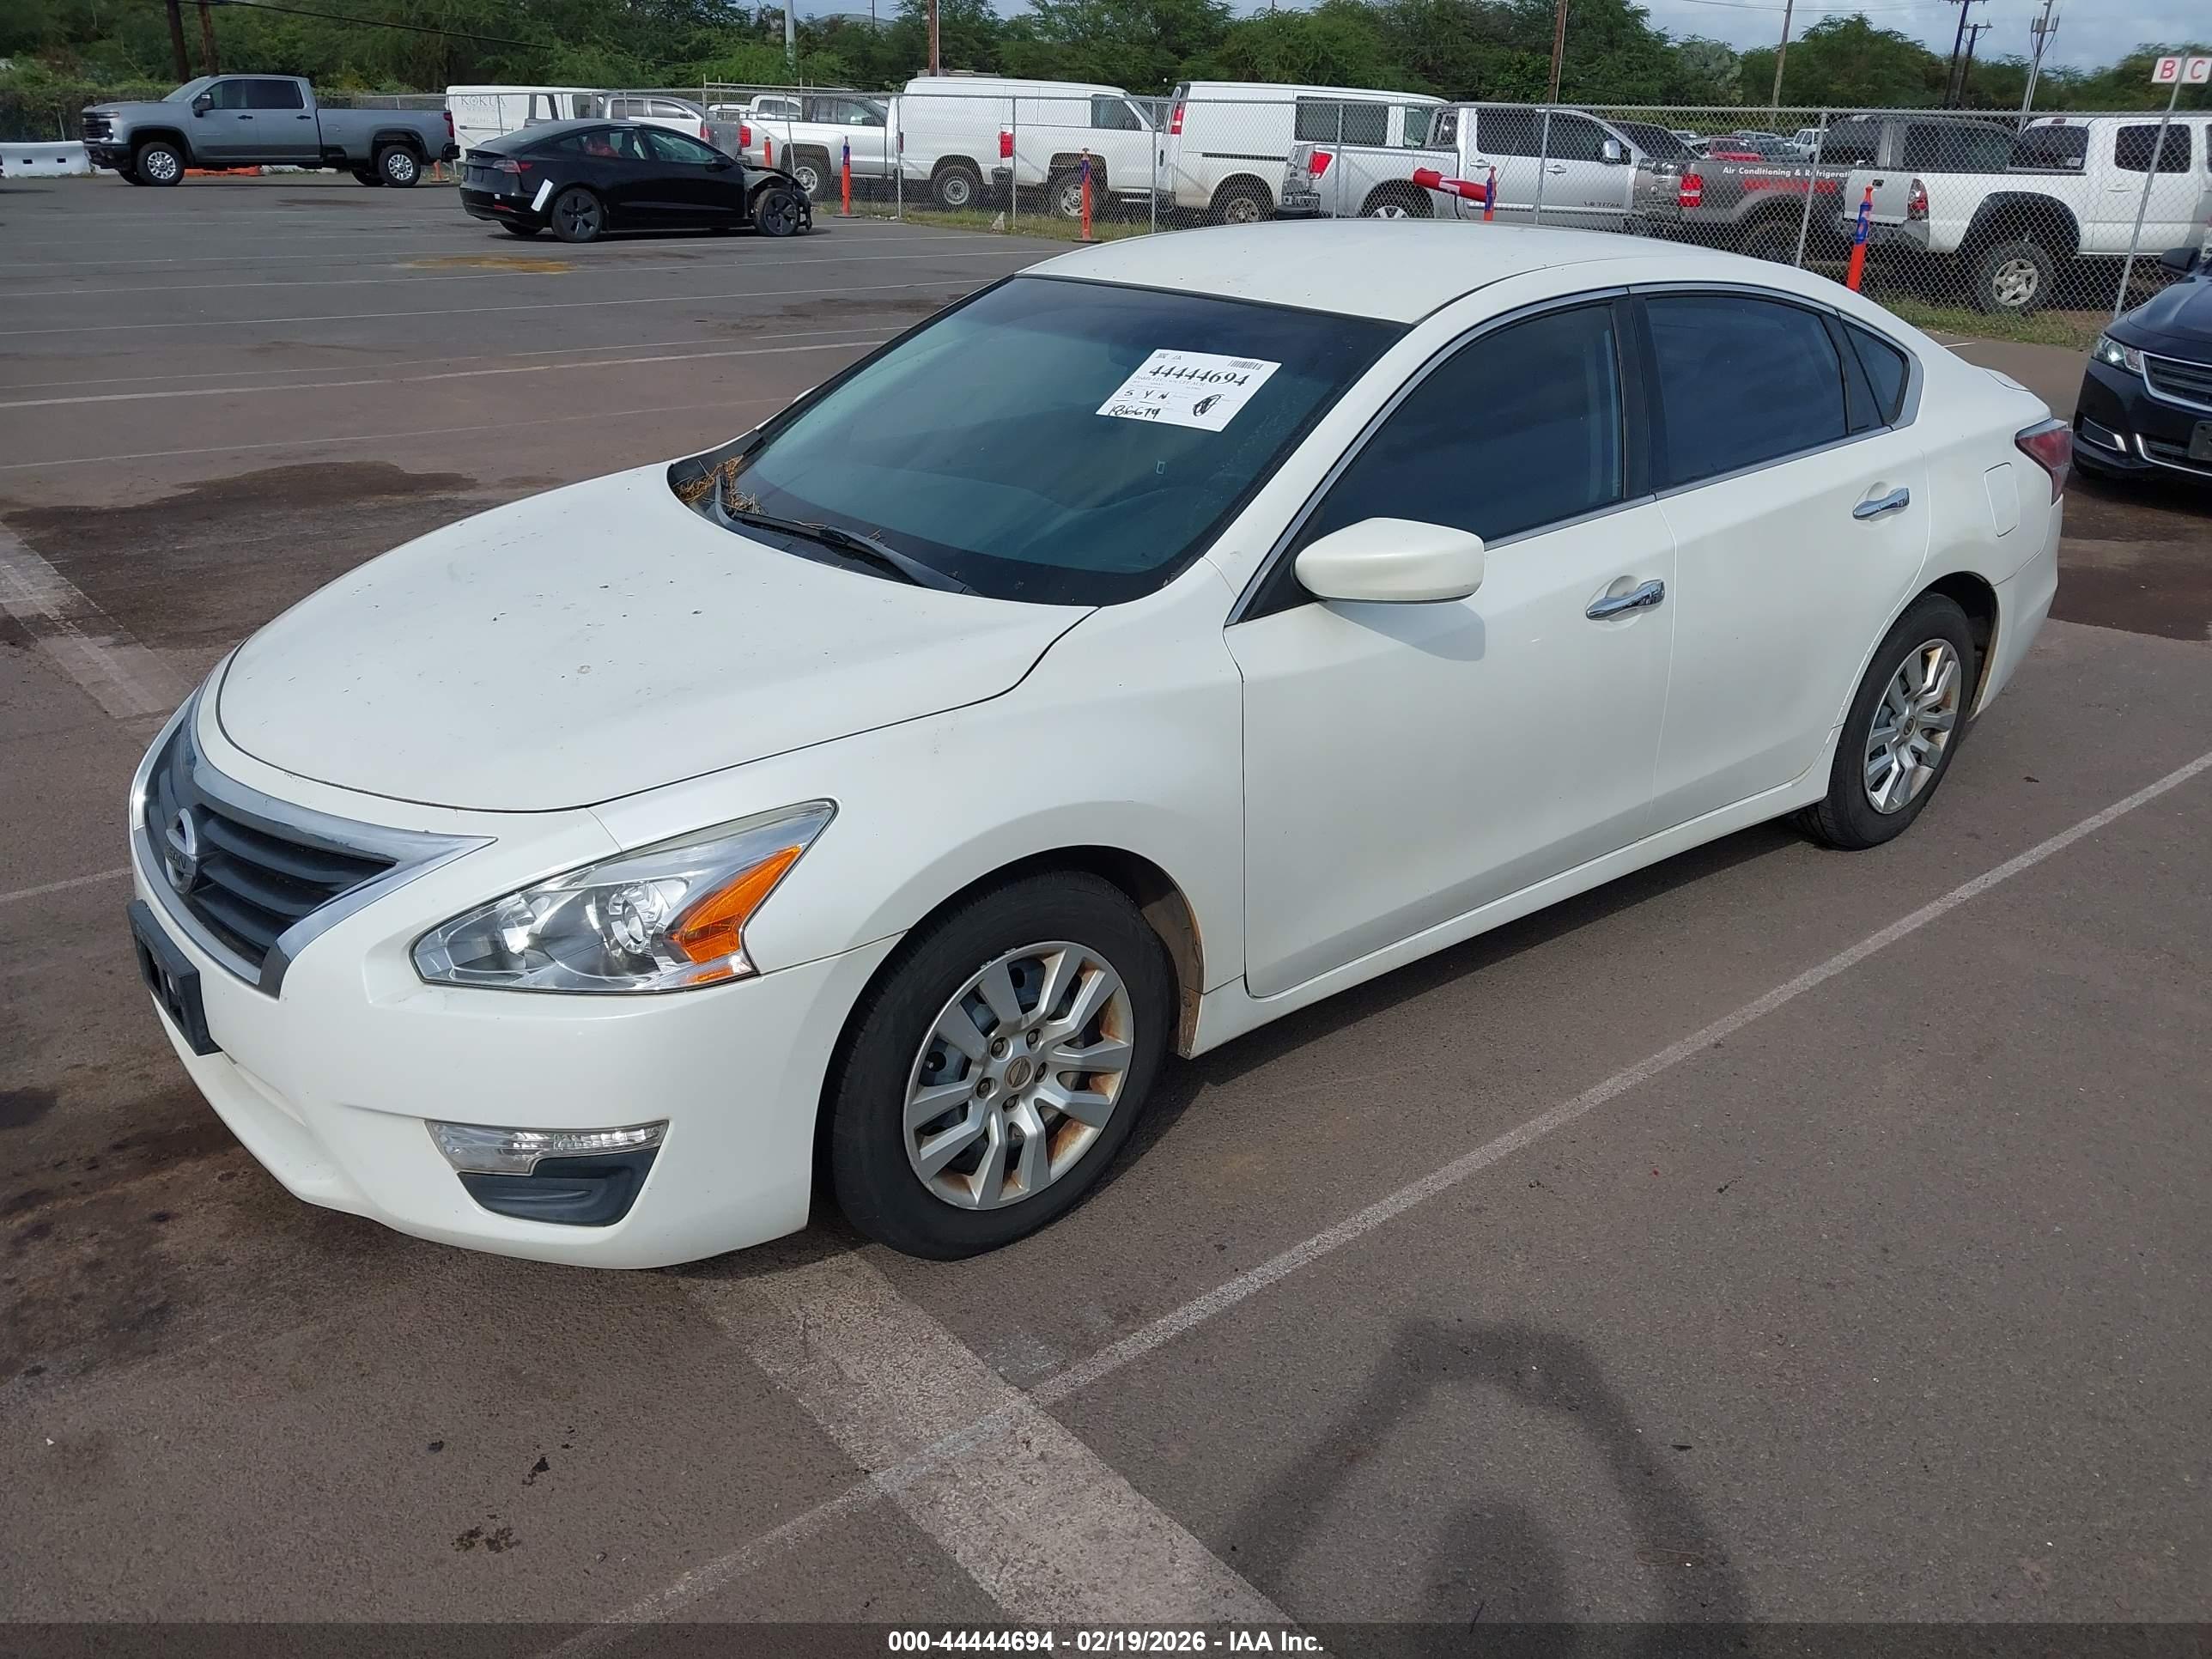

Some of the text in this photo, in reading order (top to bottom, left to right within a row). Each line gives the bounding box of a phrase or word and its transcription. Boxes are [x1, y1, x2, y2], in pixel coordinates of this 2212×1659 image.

[2160, 60, 2176, 79] B
[2191, 59, 2206, 79] C
[1739, 167, 1791, 178] Conditioning
[1149, 364, 1250, 386] 44444694
